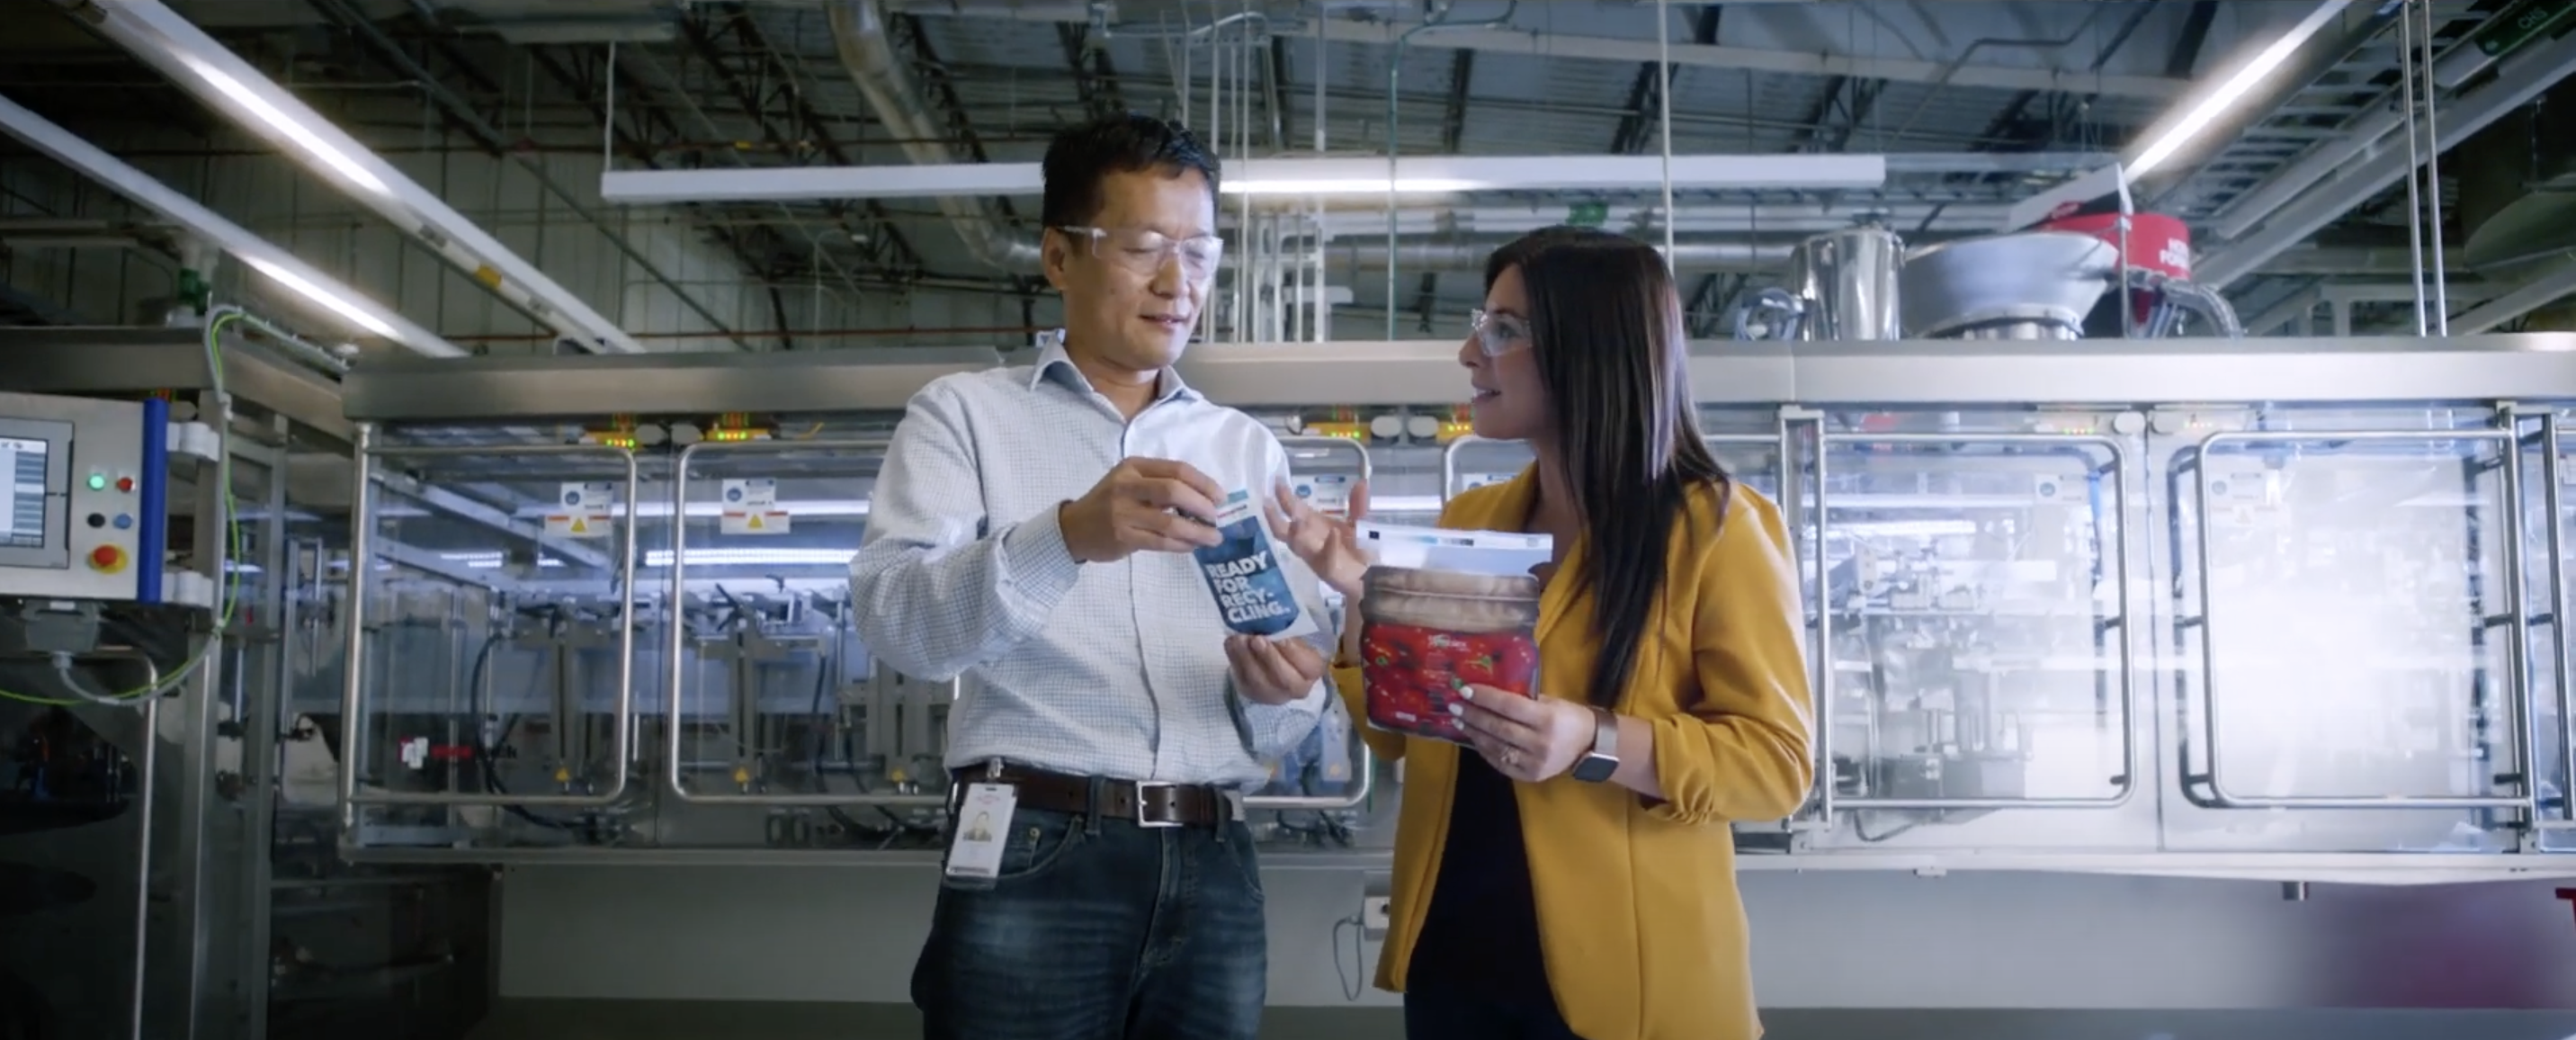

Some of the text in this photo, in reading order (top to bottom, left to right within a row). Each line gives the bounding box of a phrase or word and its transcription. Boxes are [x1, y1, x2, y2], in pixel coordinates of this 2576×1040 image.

[1205, 550, 1268, 578] READY
[1213, 576, 1250, 594] FOR
[1220, 587, 1275, 609] RECY-
